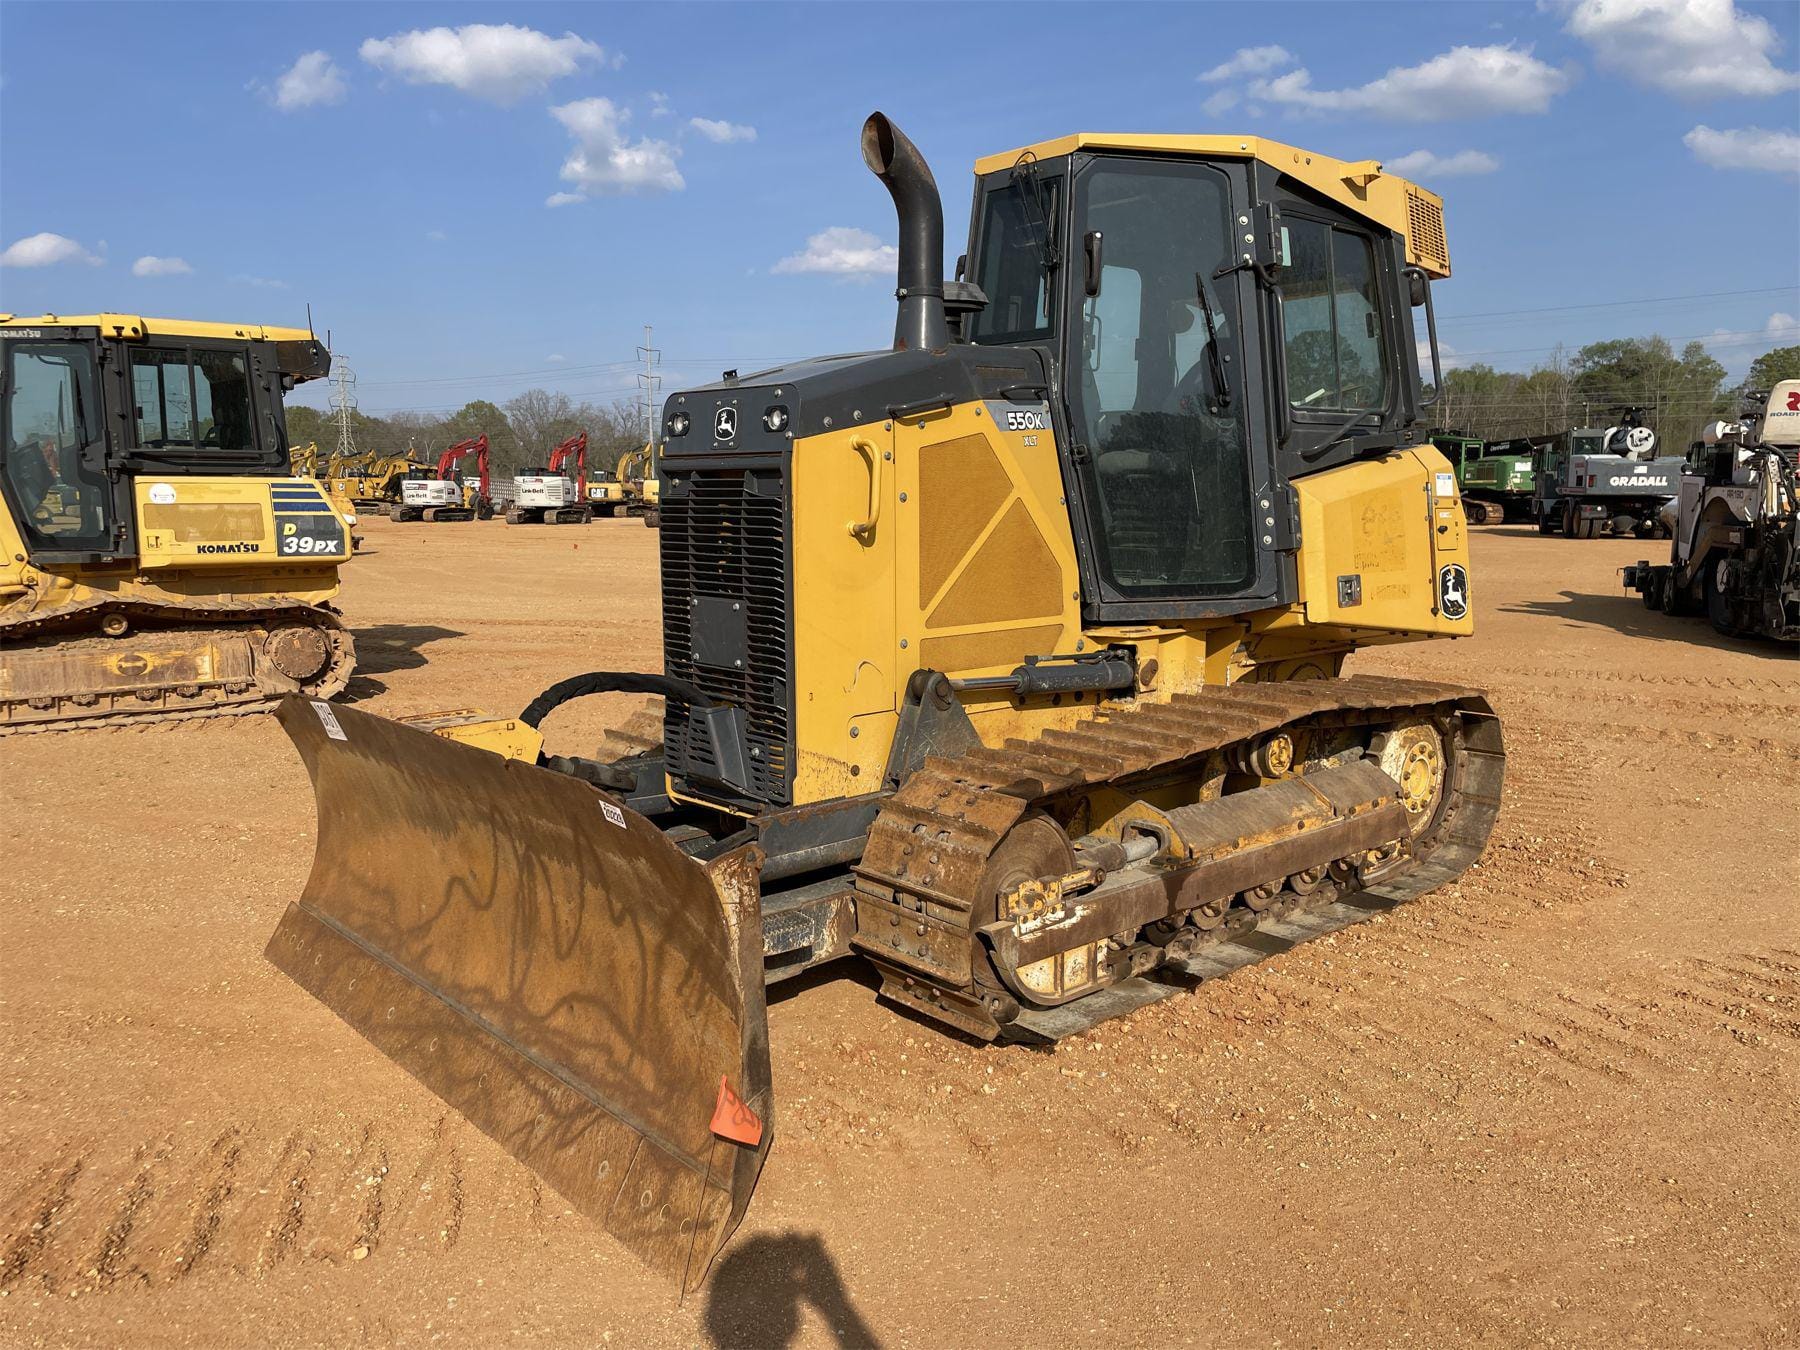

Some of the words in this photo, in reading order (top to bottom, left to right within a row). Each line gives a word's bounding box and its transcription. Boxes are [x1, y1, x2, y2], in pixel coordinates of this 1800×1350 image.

[1006, 411, 1045, 431] 550K
[1023, 435, 1039, 447] XLT
[1609, 476, 1669, 487] GRADALL
[590, 488, 606, 498] CAT
[283, 523, 297, 536] D
[197, 542, 259, 554] KOMATSU
[283, 536, 338, 554] 39PX
